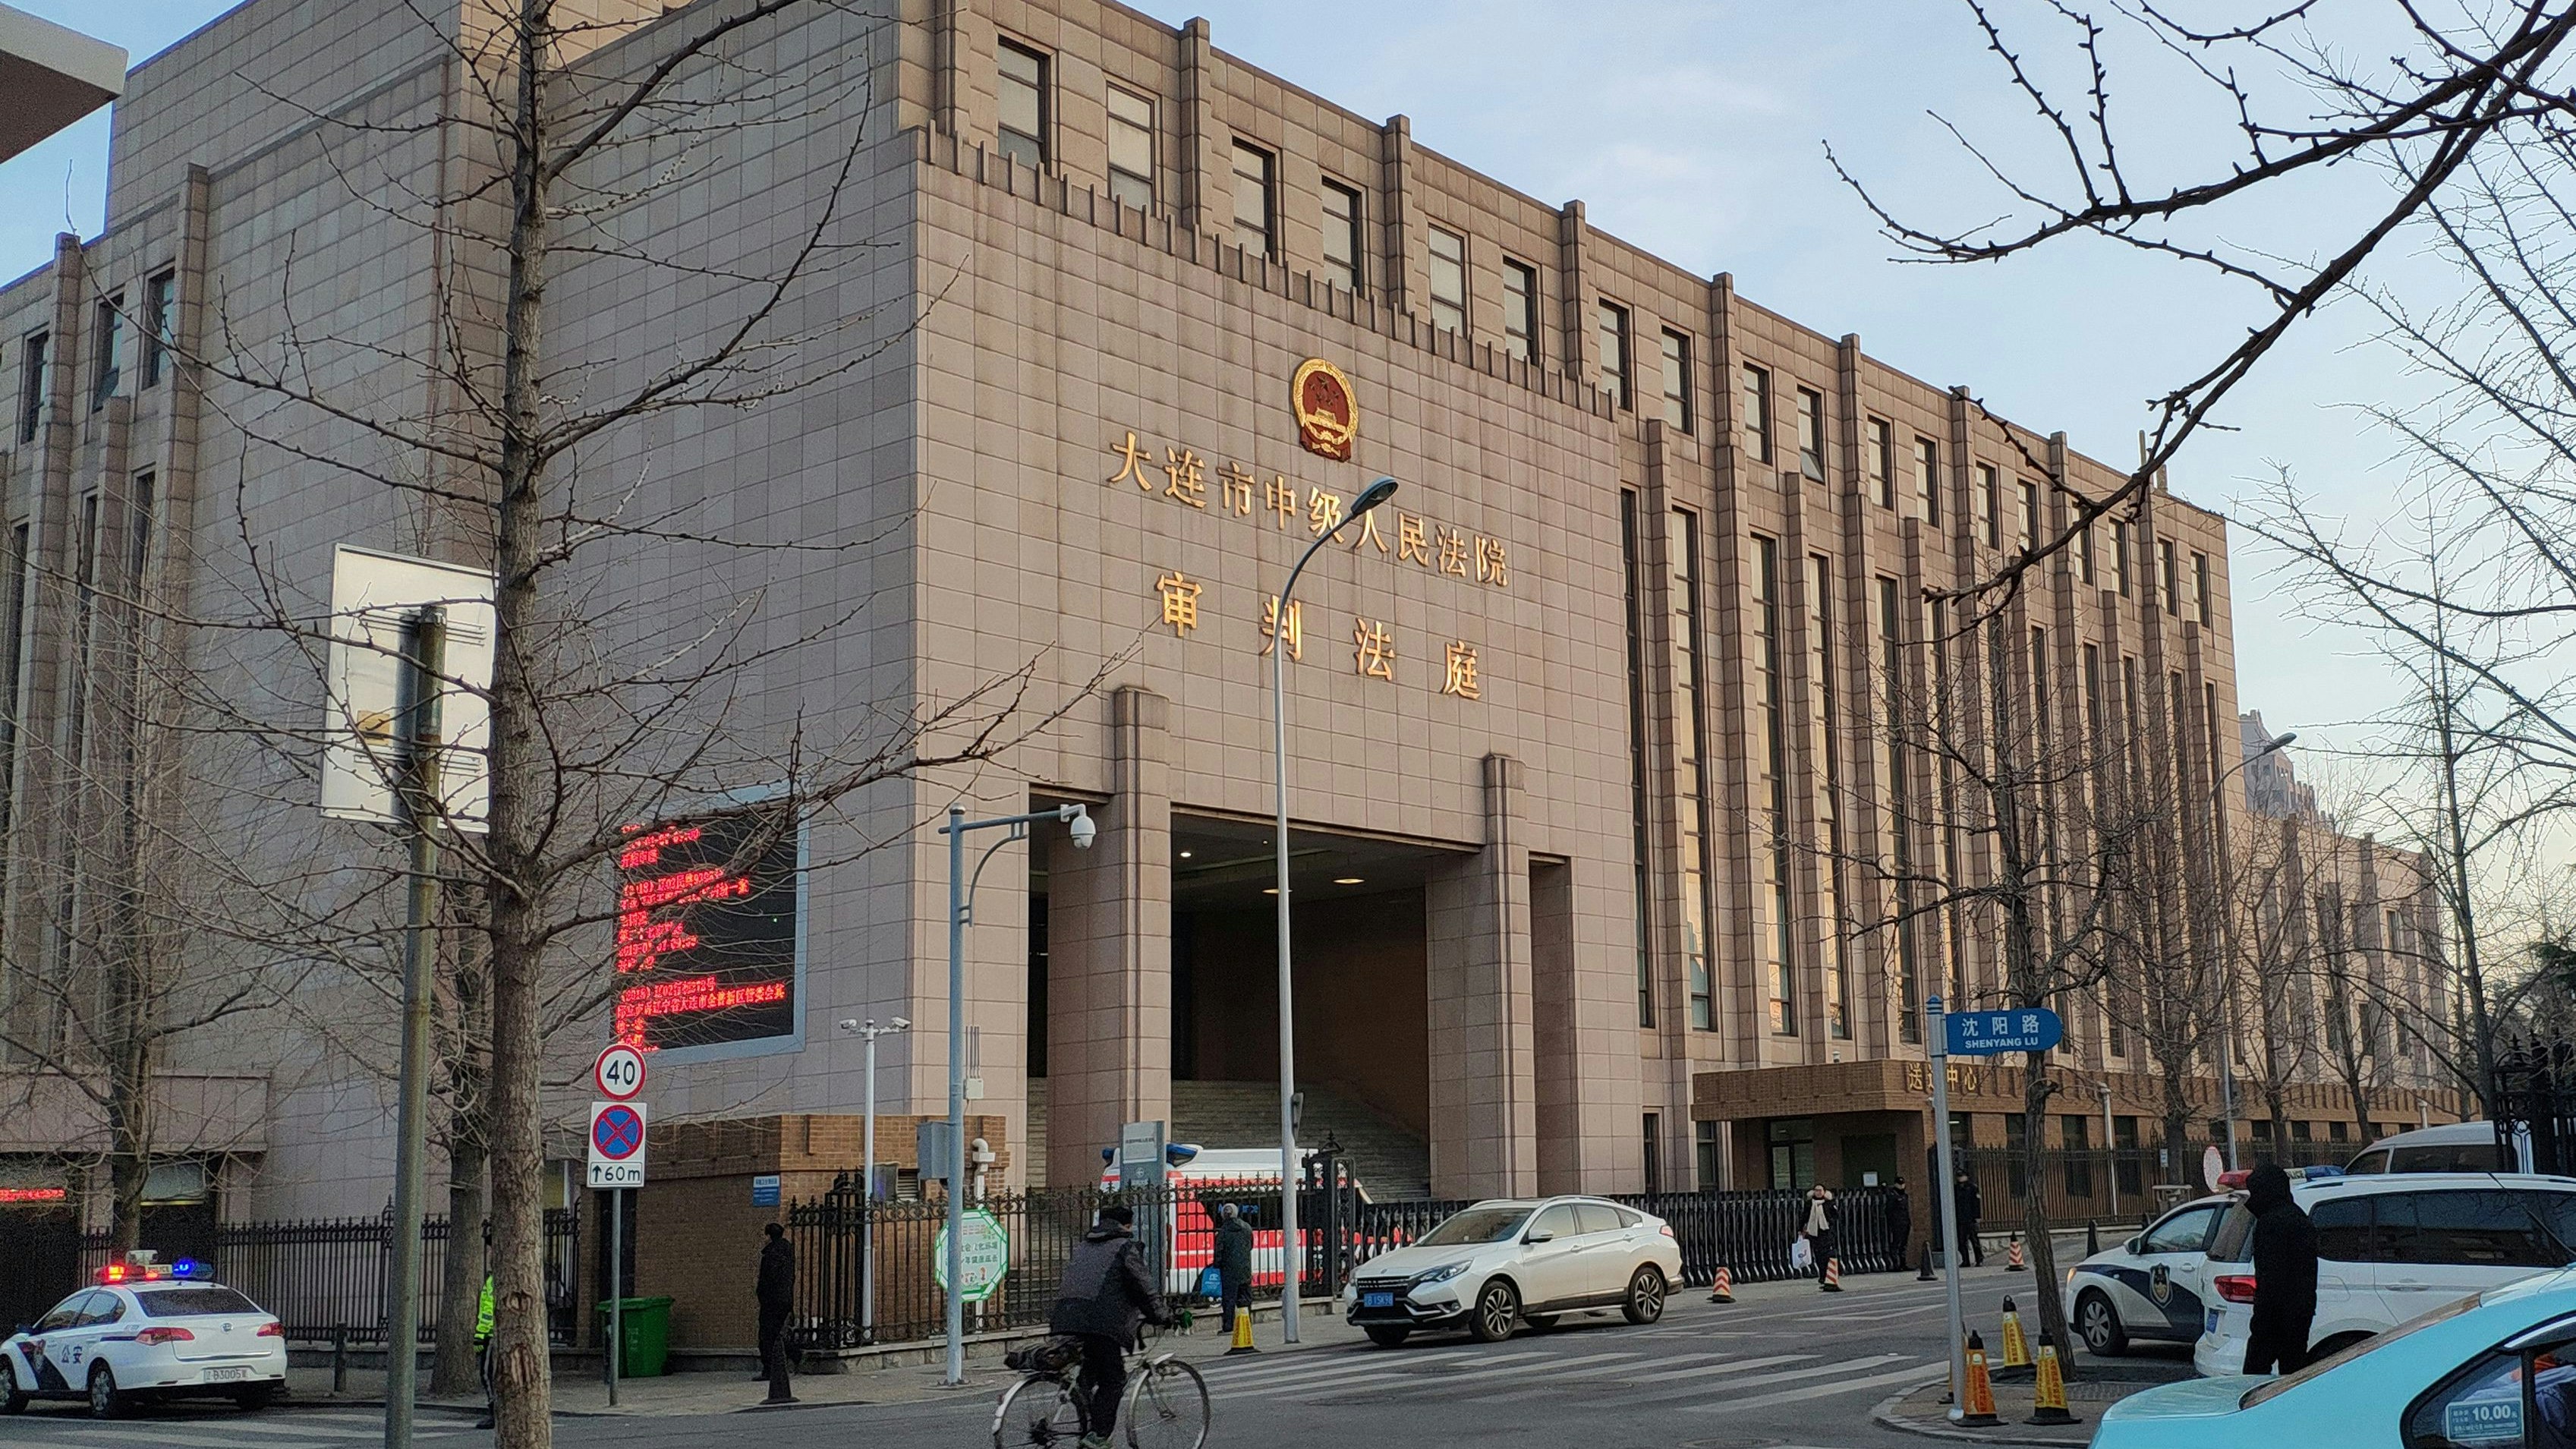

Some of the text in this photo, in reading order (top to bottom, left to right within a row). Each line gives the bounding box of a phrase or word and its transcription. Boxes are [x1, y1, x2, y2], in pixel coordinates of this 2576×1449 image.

[1108, 431, 1509, 587] 大连市中级人民法院
[1154, 572, 1482, 701] 审判法庭
[1962, 1014, 2039, 1037] 沈阳路
[1965, 1037, 2038, 1049] SHENYANG LU
[606, 1060, 635, 1085] 40
[605, 1166, 641, 1181] 60m
[61, 1344, 83, 1364] 公安
